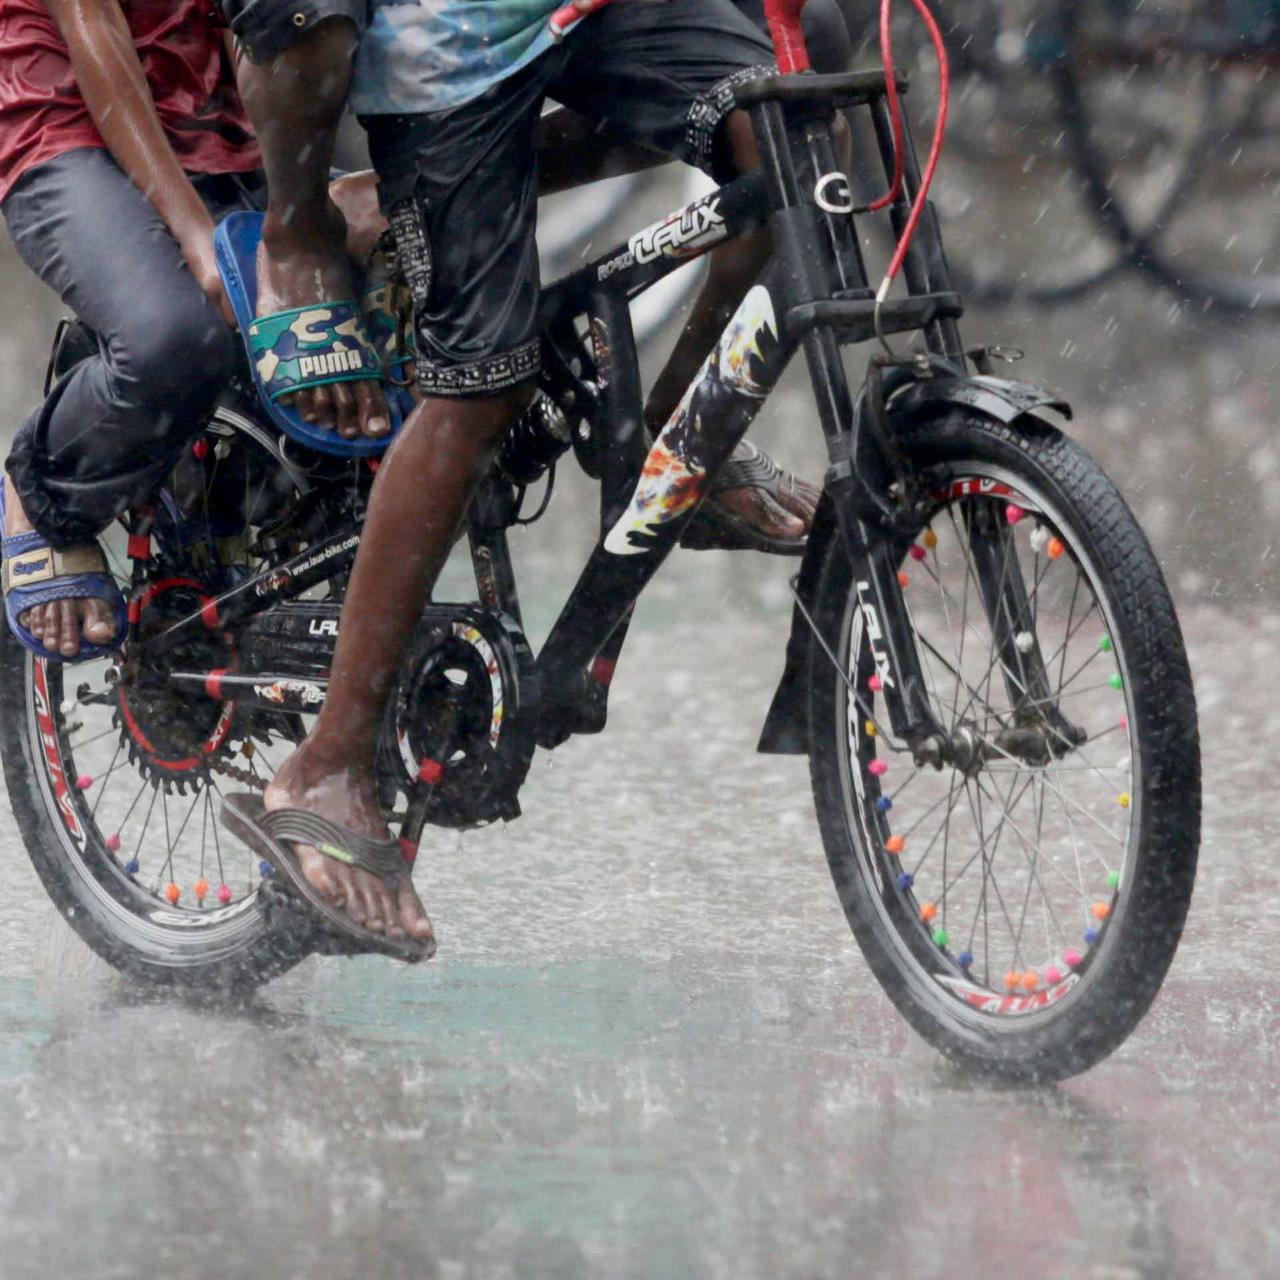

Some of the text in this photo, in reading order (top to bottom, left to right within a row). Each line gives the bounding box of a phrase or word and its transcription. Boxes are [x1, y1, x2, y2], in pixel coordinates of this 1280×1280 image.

[631, 197, 725, 265] LAUX
[299, 349, 363, 378] PUMA
[291, 534, 361, 577] www.laux-bike.com
[308, 618, 339, 636] LAU
[856, 580, 895, 690] LAUX
